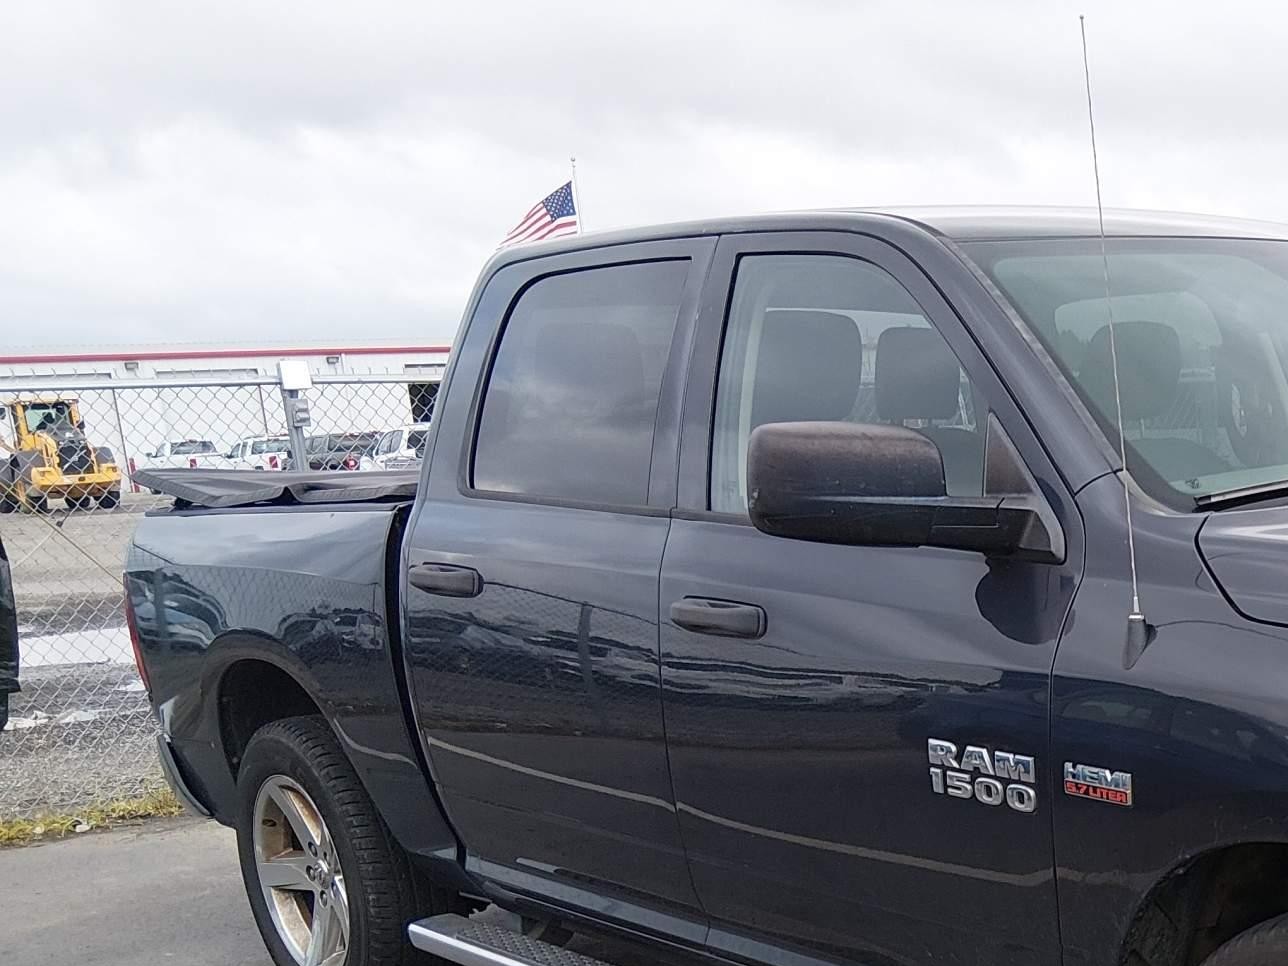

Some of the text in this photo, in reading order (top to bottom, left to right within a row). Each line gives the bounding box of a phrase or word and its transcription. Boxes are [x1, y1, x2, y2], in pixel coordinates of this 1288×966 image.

[928, 738, 1036, 783] RAM
[1064, 762, 1132, 788] HEMI
[930, 767, 1036, 813] 1500
[1066, 782, 1127, 802] 5.7 LITER
